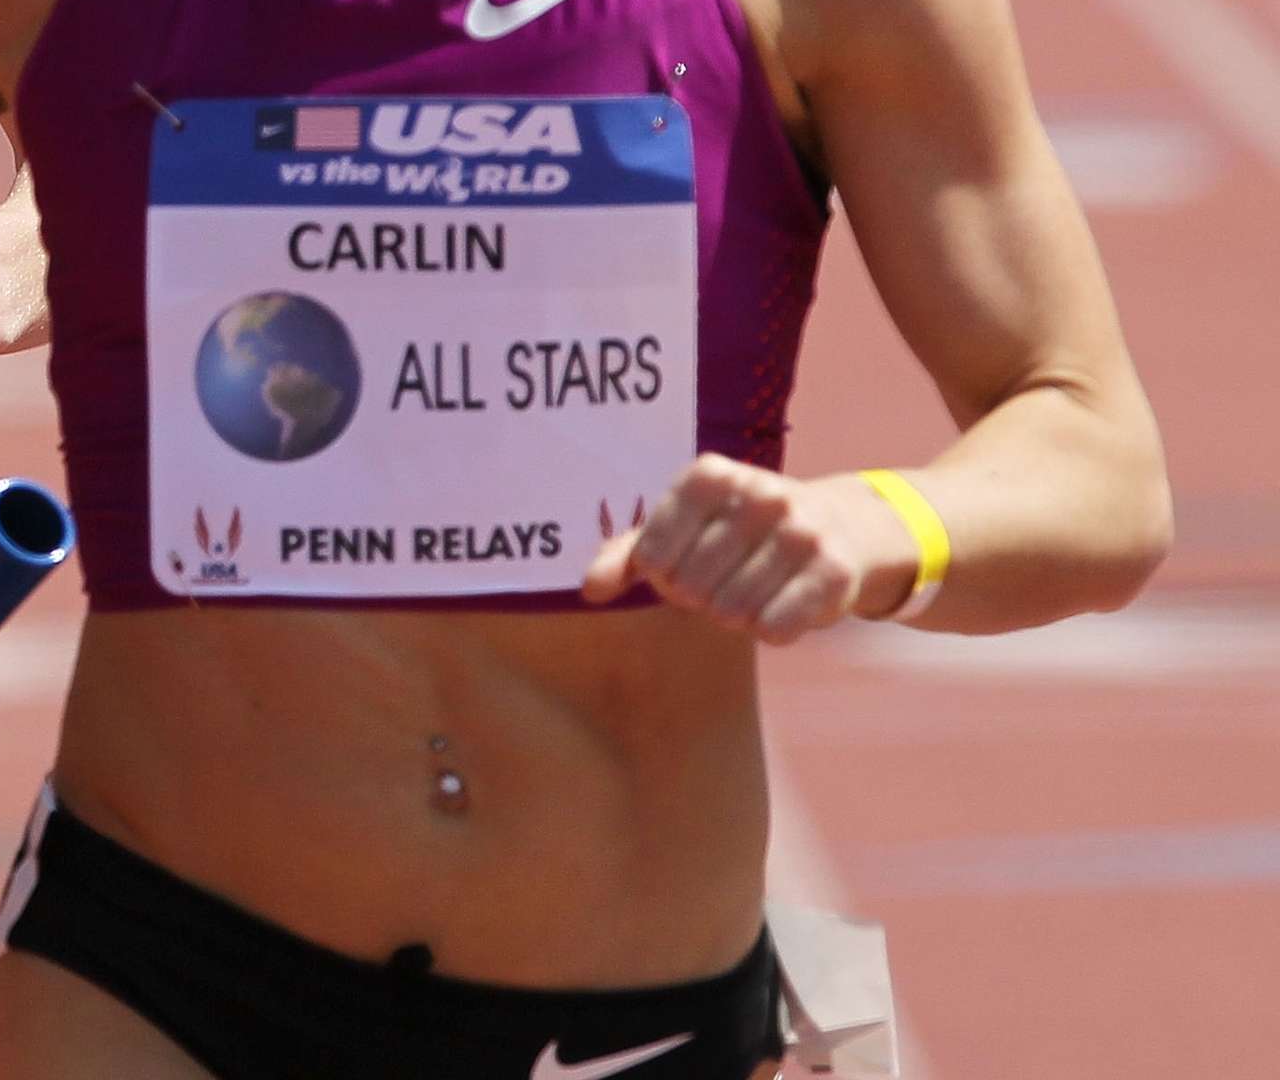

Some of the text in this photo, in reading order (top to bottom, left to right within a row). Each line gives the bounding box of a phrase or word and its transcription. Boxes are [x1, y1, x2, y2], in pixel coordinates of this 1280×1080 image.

[368, 103, 583, 157] USA
[279, 161, 318, 186] vs
[321, 156, 381, 186] the
[288, 222, 506, 272] CARLIN
[391, 335, 663, 410] ALL STARS
[279, 521, 562, 564] PENN RELAYS
